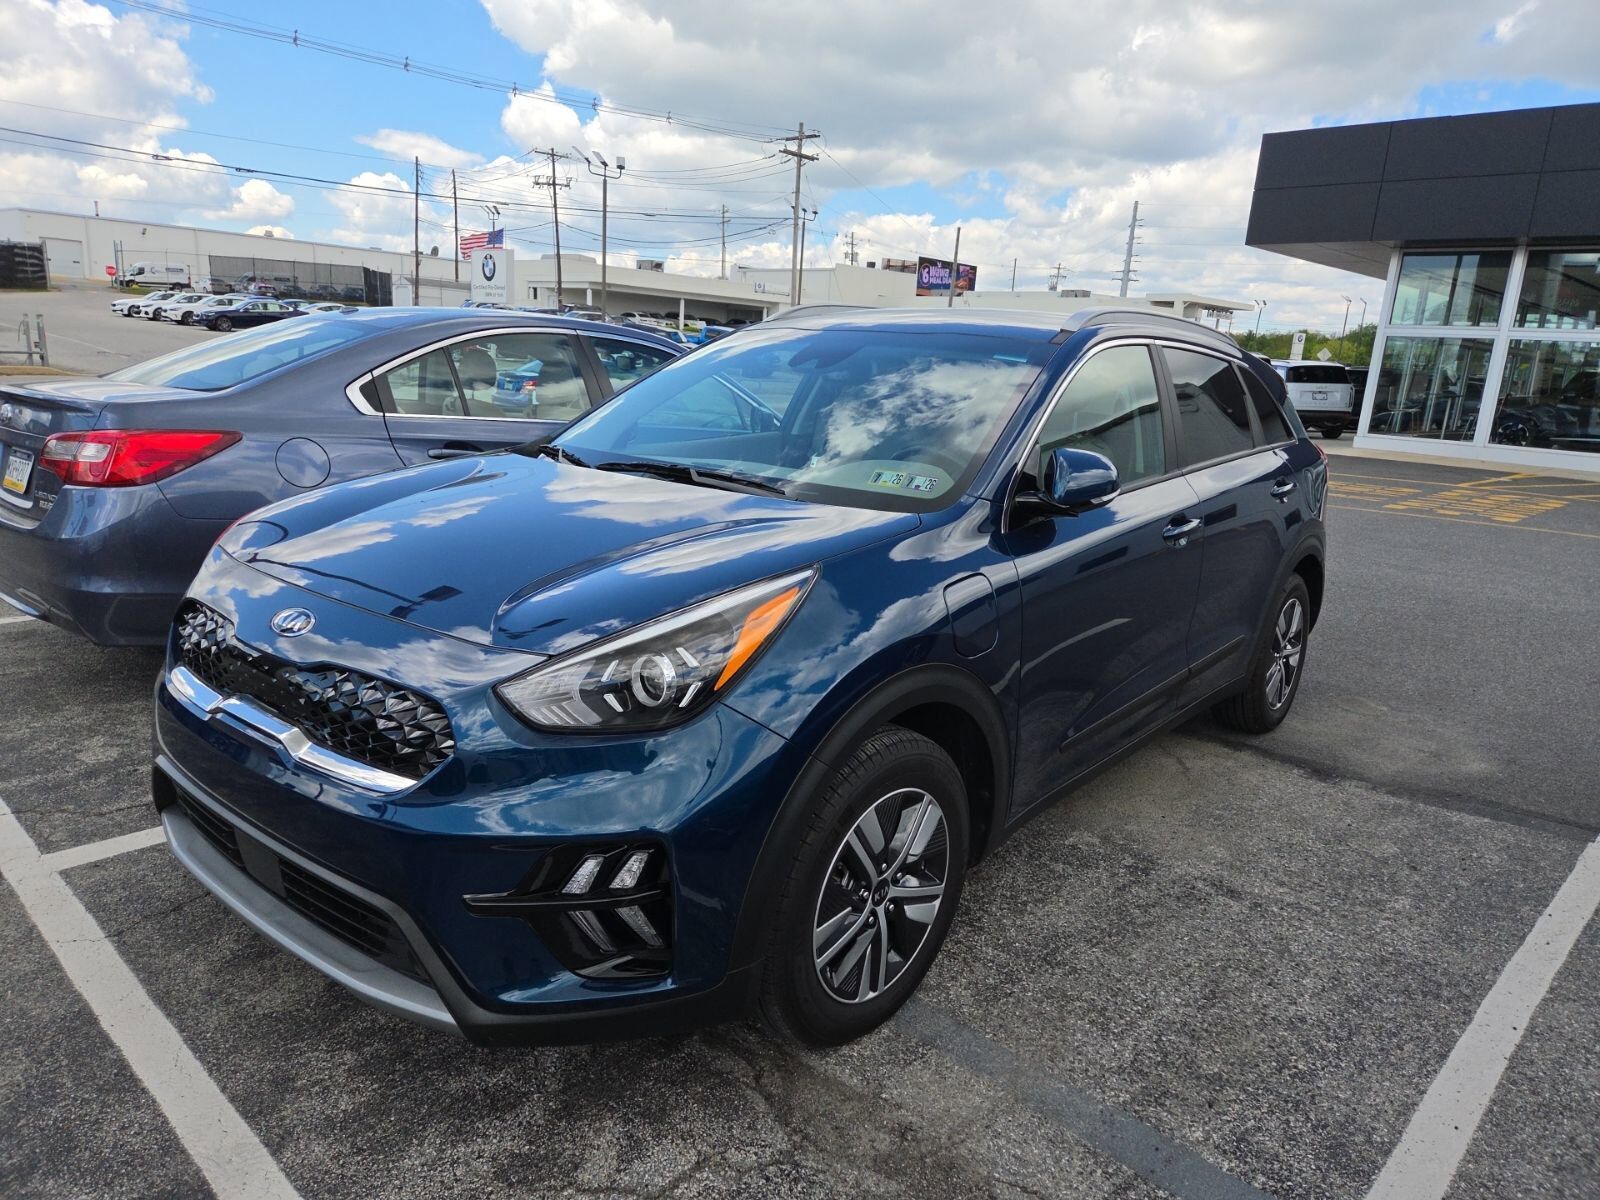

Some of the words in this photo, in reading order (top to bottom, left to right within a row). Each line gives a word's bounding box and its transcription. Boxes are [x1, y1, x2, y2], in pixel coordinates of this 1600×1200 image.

[930, 265, 950, 278] Wawa
[892, 473, 904, 485] 26
[925, 478, 937, 490] 26
[874, 886, 890, 902] KIA
